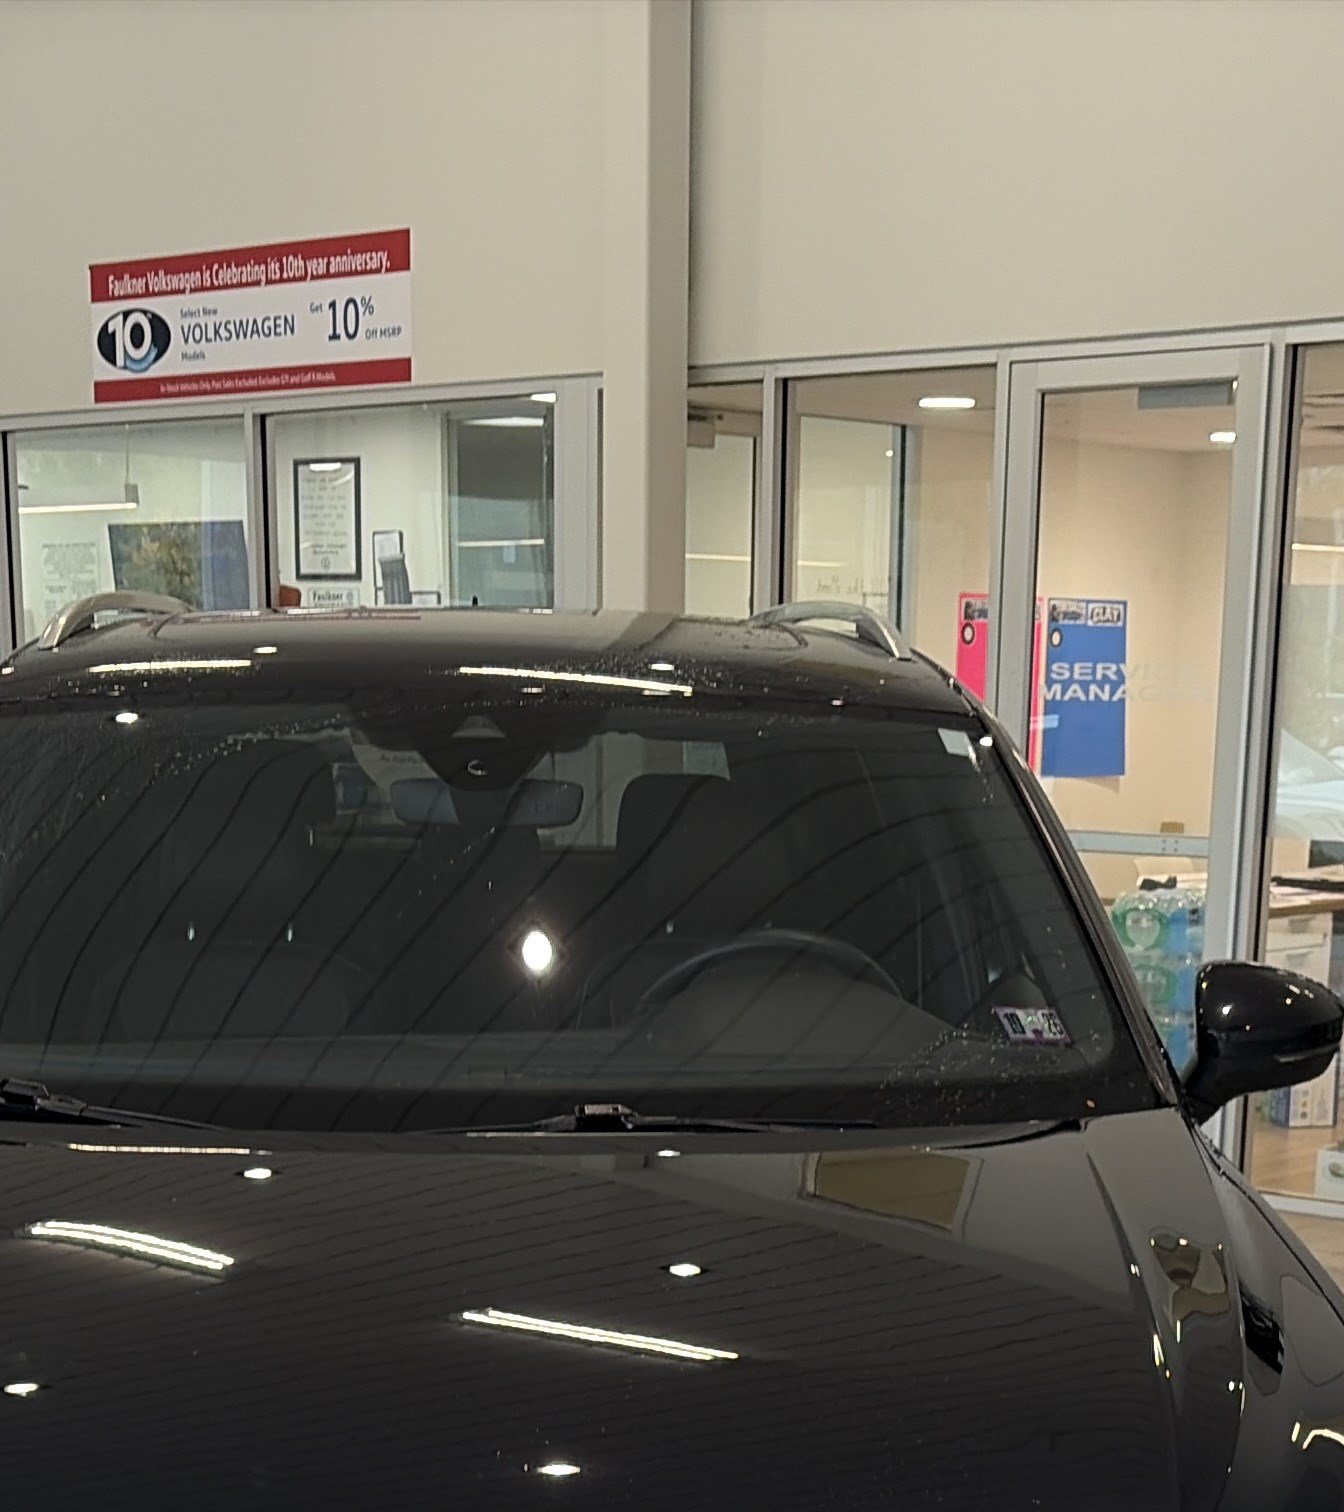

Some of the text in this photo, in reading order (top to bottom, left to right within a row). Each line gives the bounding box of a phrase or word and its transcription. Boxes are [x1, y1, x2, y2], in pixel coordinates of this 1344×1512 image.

[108, 273, 146, 297] Faulkner
[147, 268, 202, 294] Volkswagen
[203, 264, 211, 287] is
[213, 259, 266, 287] Celebrating
[282, 253, 305, 278] 10th
[306, 256, 328, 282] year
[107, 310, 153, 369] 10
[180, 314, 295, 345] VOLKSWAGEN
[379, 325, 403, 339] MSRP
[1050, 661, 1146, 681] SERV
[1041, 682, 1156, 702] MANA
